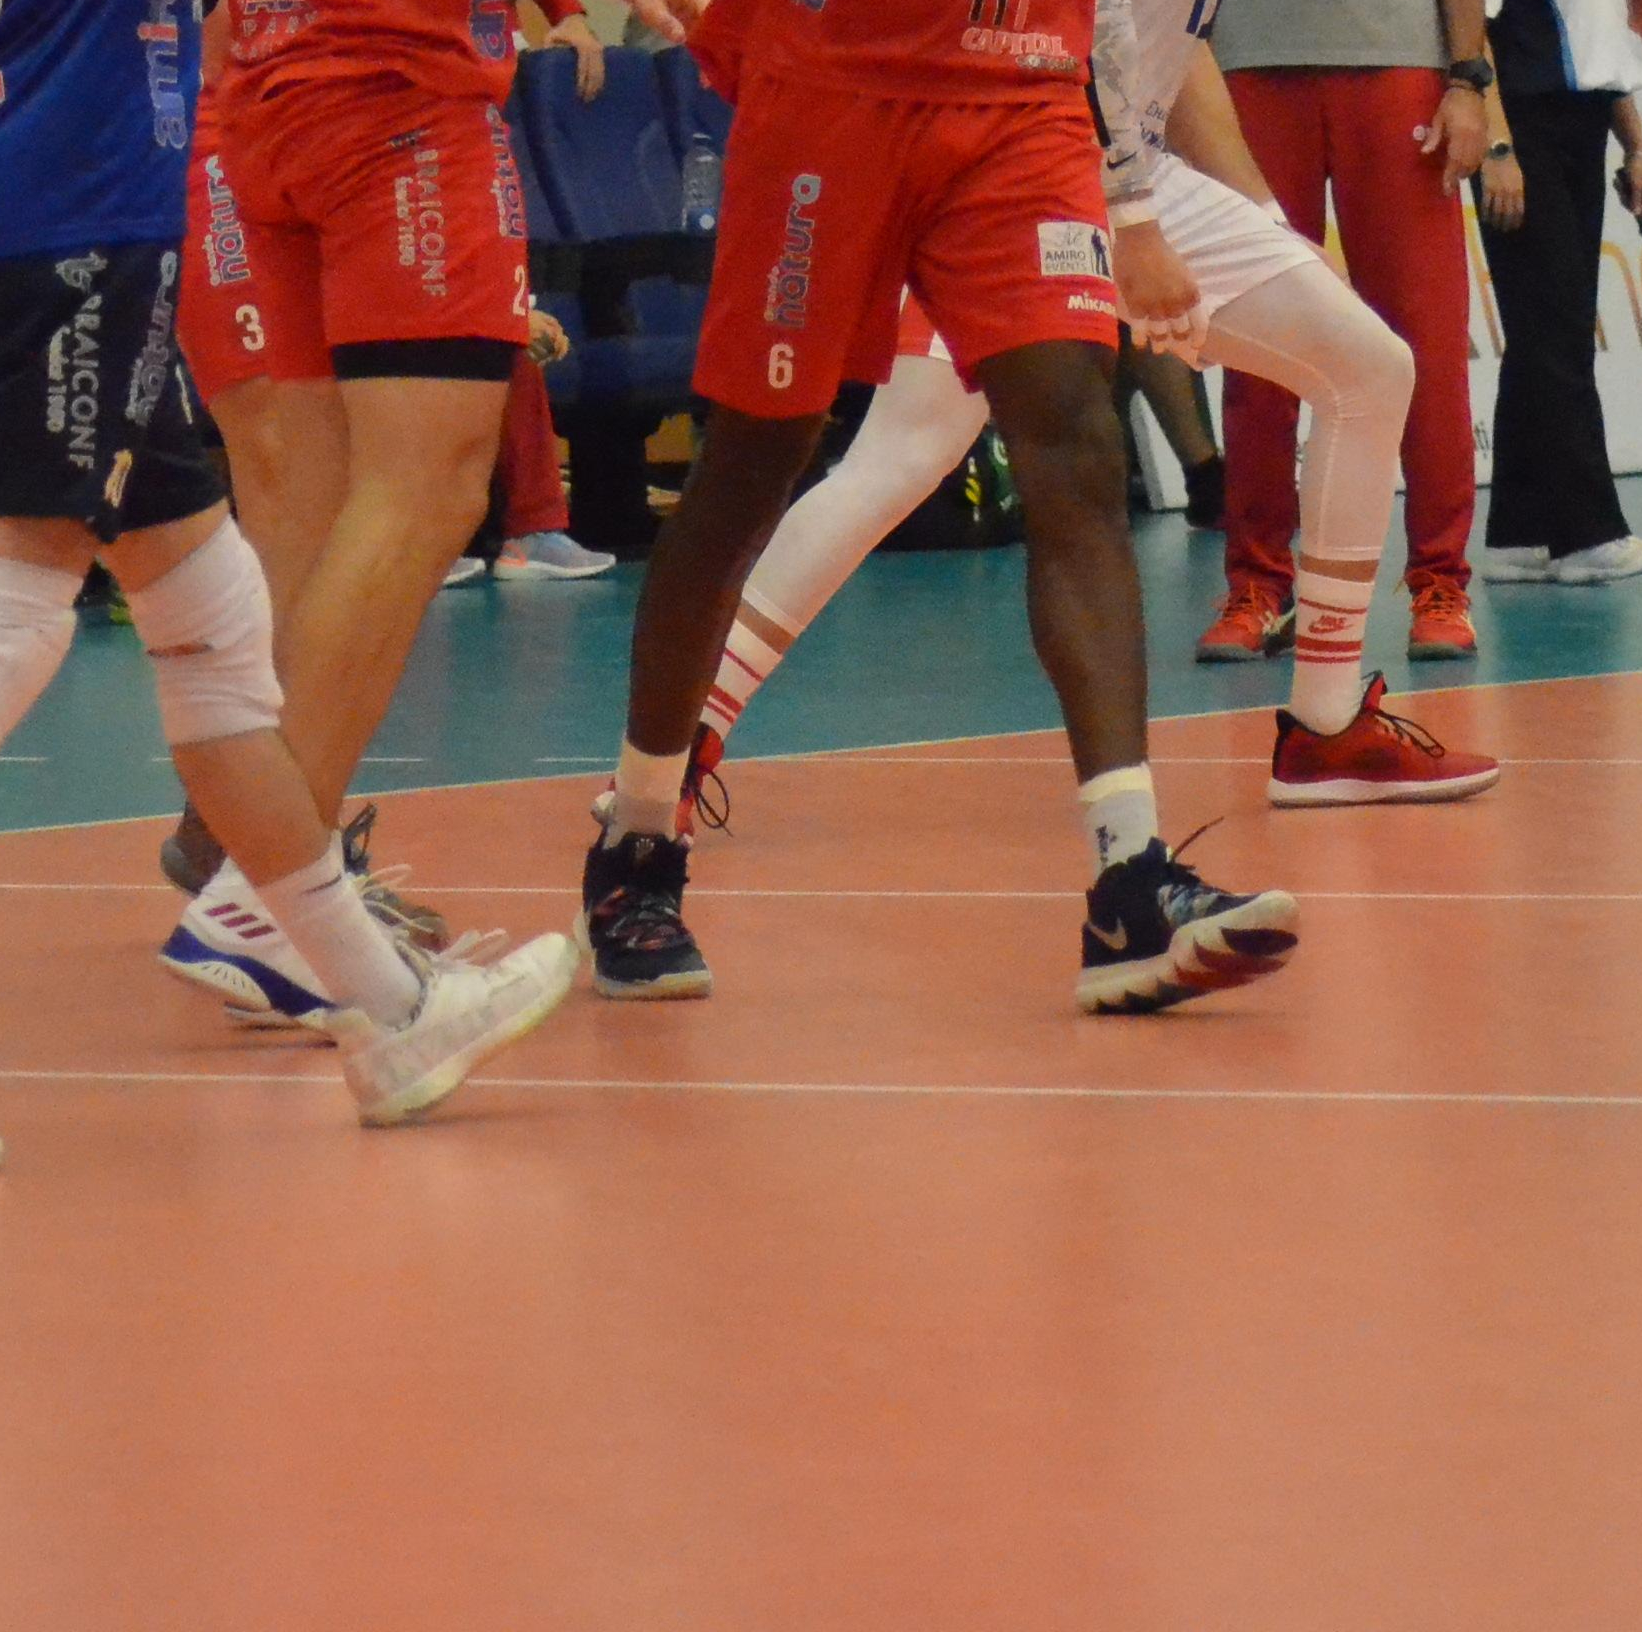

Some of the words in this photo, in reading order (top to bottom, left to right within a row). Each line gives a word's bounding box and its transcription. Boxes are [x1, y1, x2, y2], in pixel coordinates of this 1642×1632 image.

[770, 173, 822, 330] natura
[512, 264, 527, 317] 2
[235, 304, 266, 352] 3
[767, 342, 795, 390] 6
